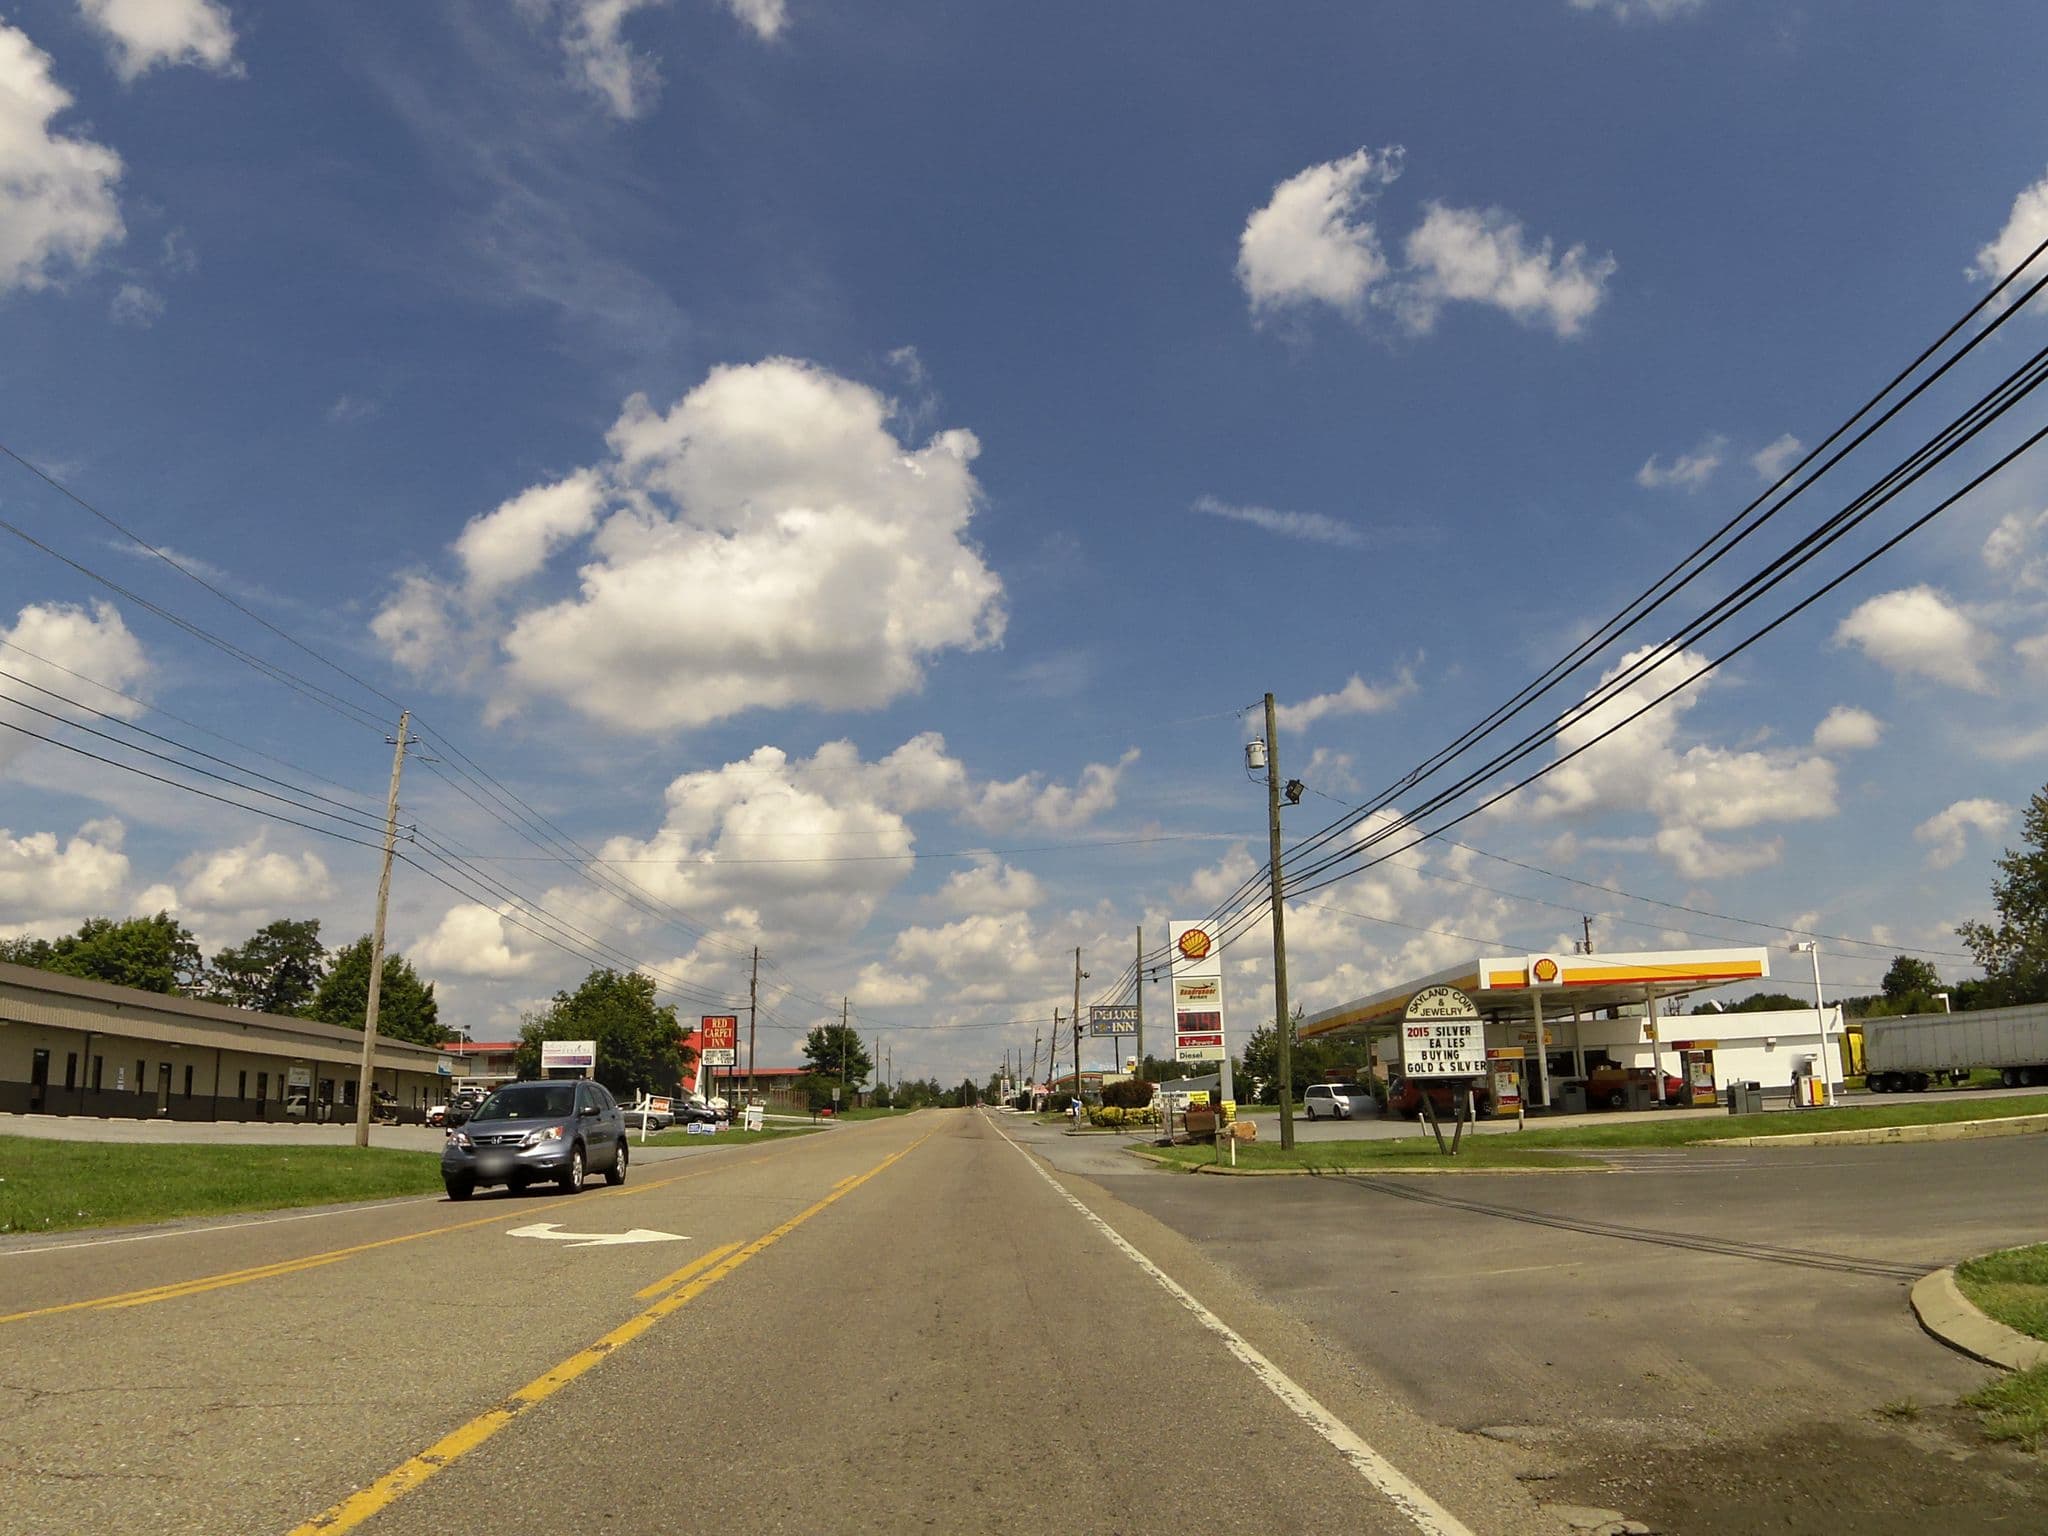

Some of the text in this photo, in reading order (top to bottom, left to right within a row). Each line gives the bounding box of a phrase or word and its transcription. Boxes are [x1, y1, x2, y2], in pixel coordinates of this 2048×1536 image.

[1410, 988, 1473, 1014] SKYLAND COIN
[1094, 1010, 1138, 1020] DELUXE
[1420, 1007, 1463, 1016] JEWELRY
[712, 1018, 728, 1028] RED
[1112, 1021, 1135, 1032] INN
[704, 1028, 732, 1038] CARPET
[1407, 1026, 1471, 1037] 2015 SILVER
[712, 1038, 725, 1047] INN
[1179, 1051, 1203, 1060] Diesel
[1421, 1050, 1460, 1060] BUYING
[1407, 1063, 1434, 1073] GOLD
[1450, 1061, 1487, 1072] SILVER
